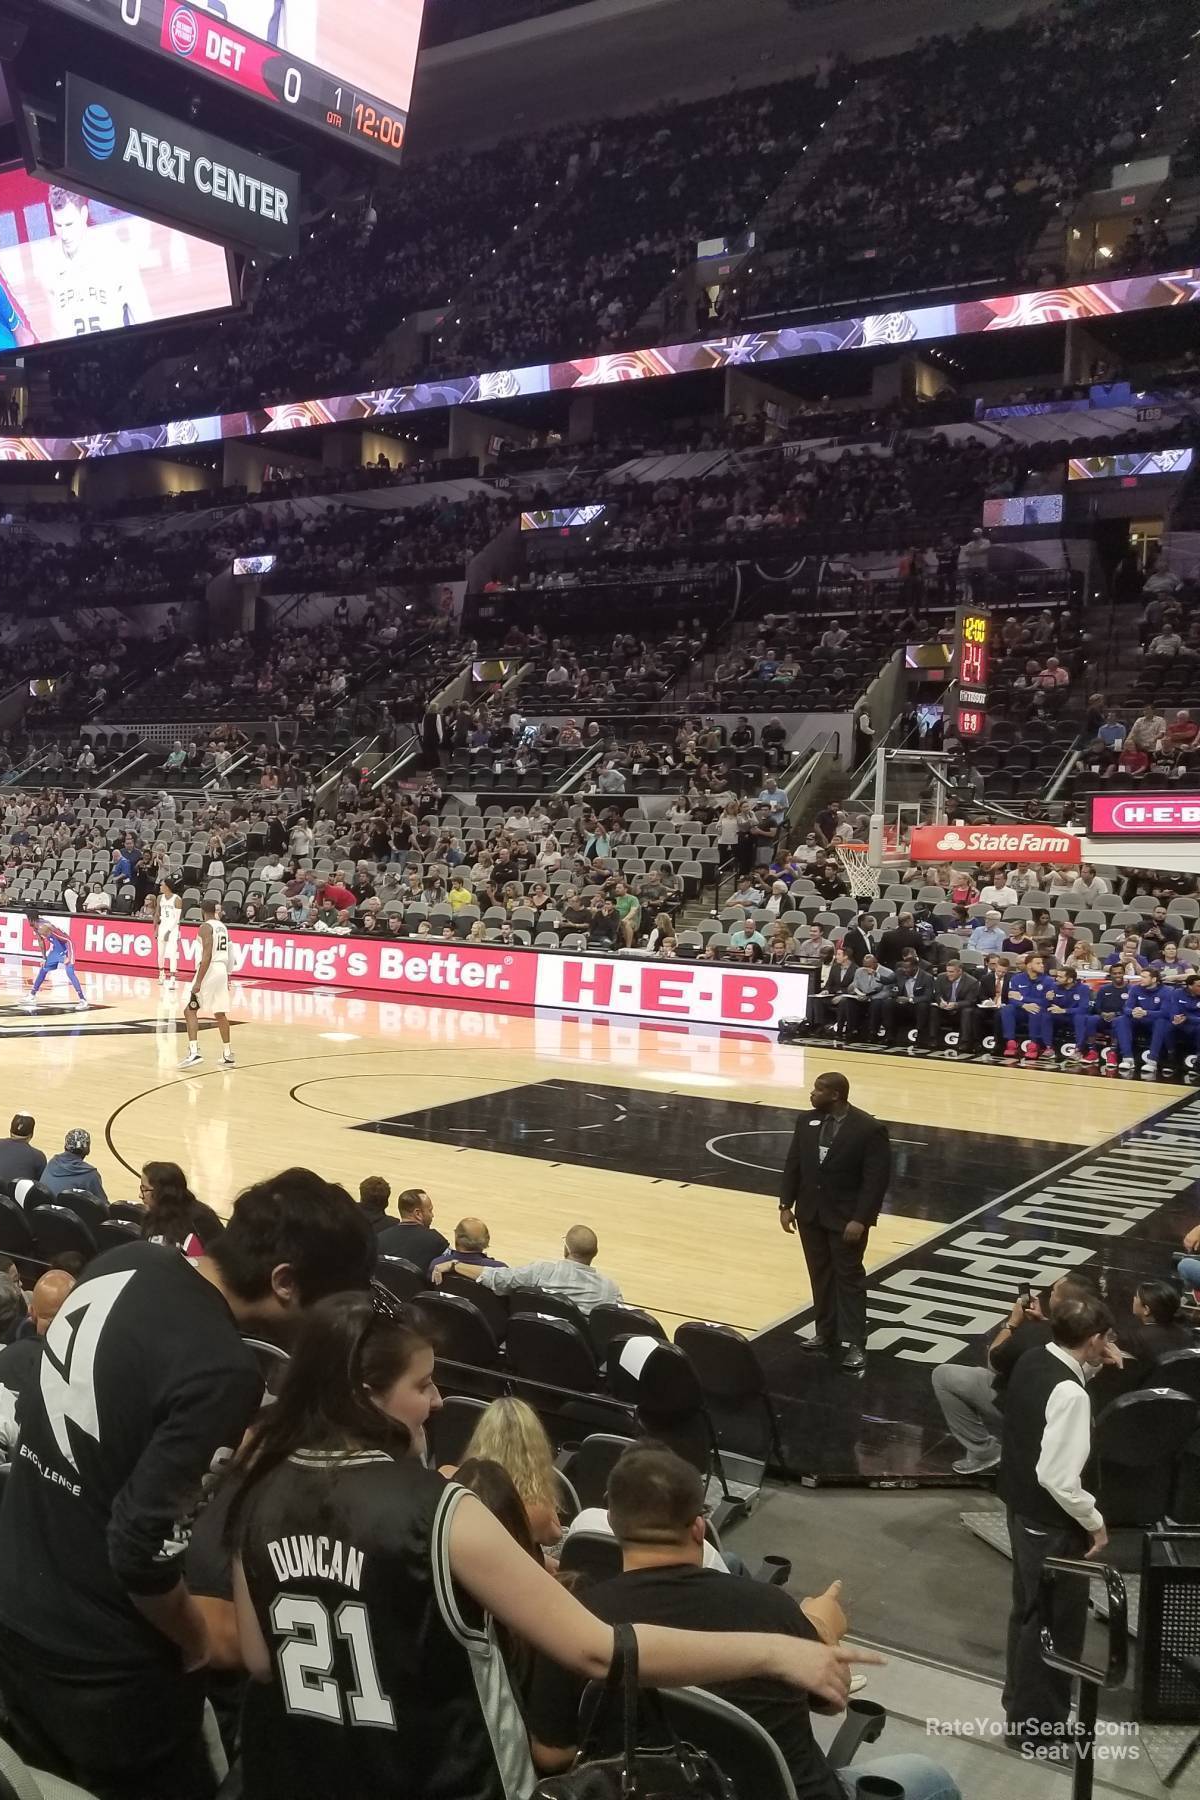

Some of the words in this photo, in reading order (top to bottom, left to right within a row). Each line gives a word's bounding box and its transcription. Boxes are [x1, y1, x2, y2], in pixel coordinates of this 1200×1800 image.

[205, 29, 245, 71] DET
[284, 68, 301, 103] 0
[355, 103, 404, 148] 12:00
[122, 128, 191, 185] AT&T
[194, 156, 289, 225] CENTER
[73, 316, 102, 337] 25
[963, 617, 986, 642] 12:00
[963, 642, 982, 682] 24
[84, 924, 153, 957] Here
[378, 947, 511, 991] Better.
[216, 935, 227, 951] 12
[562, 960, 779, 1022] H-E-B
[944, 1031, 961, 1045] G
[982, 1035, 996, 1049] G
[1060, 1042, 1077, 1057] G
[266, 1534, 365, 1592] DUNCAN
[268, 1591, 398, 1732] 21
